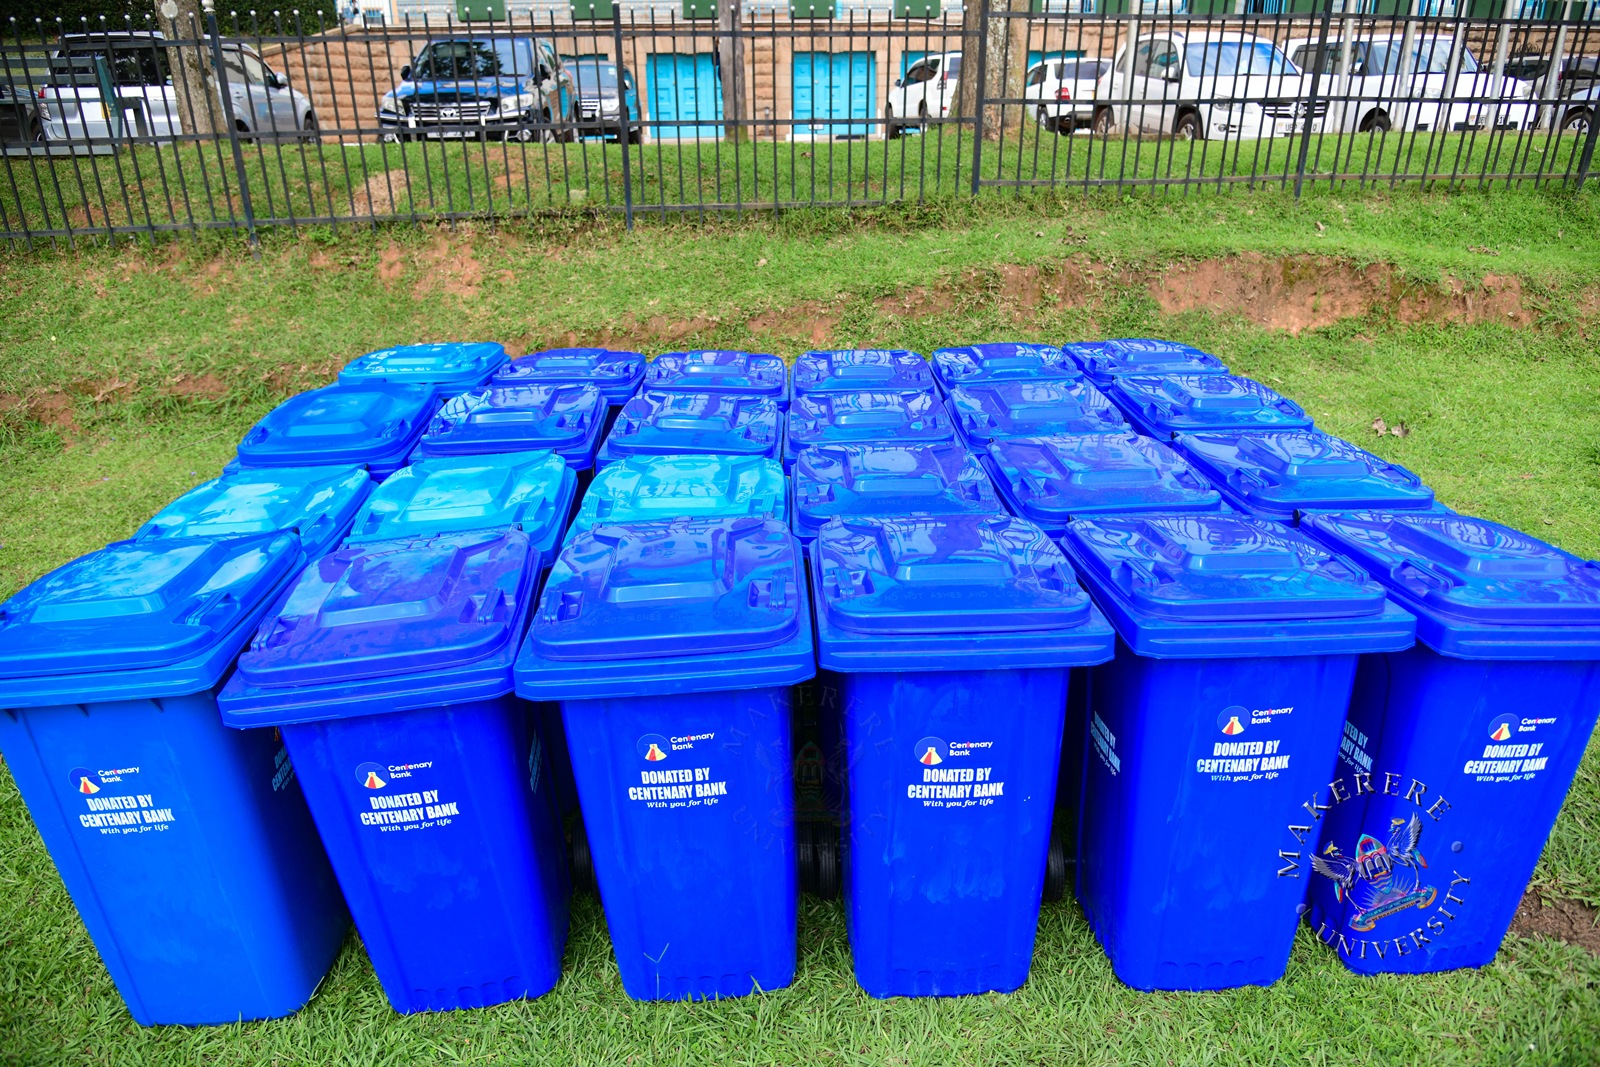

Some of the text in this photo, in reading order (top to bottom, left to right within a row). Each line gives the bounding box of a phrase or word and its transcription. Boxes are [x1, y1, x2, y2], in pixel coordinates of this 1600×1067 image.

[1252, 707, 1294, 717] Centenary
[1251, 717, 1272, 725] Bank
[1521, 717, 1557, 725] Centenary
[670, 732, 715, 743] Centenary
[671, 742, 694, 751] Bank
[949, 741, 993, 749] Centenary
[1213, 739, 1280, 757] DONATED BY
[1482, 742, 1544, 759] DONATED BY
[388, 761, 433, 772] Centenary
[1196, 755, 1290, 773] CENTENARY BANK
[1463, 757, 1549, 774] CENTENARY BANK
[97, 766, 140, 777] Centenary
[389, 771, 412, 779] Bank
[641, 767, 710, 784] DONATED BY
[923, 767, 992, 783] DONATED BY
[1211, 771, 1279, 783] With you for life
[1494, 775, 1510, 783] you
[1523, 772, 1536, 780] life
[628, 781, 728, 801] CENTENARY BANK
[907, 782, 1004, 799] CENTENARY BANK
[86, 794, 154, 812] DONATED BY
[369, 789, 439, 810] DONATED BY
[669, 801, 686, 809] you
[686, 799, 702, 808] for
[703, 798, 719, 806] life
[945, 801, 962, 809] you
[962, 800, 977, 808] for
[979, 798, 994, 806] life
[79, 808, 176, 828] CENTENARY BANK
[360, 802, 460, 826] CENTENARY BANK
[100, 824, 169, 835] With you for life
[420, 821, 435, 830] for
[436, 818, 452, 827] life
